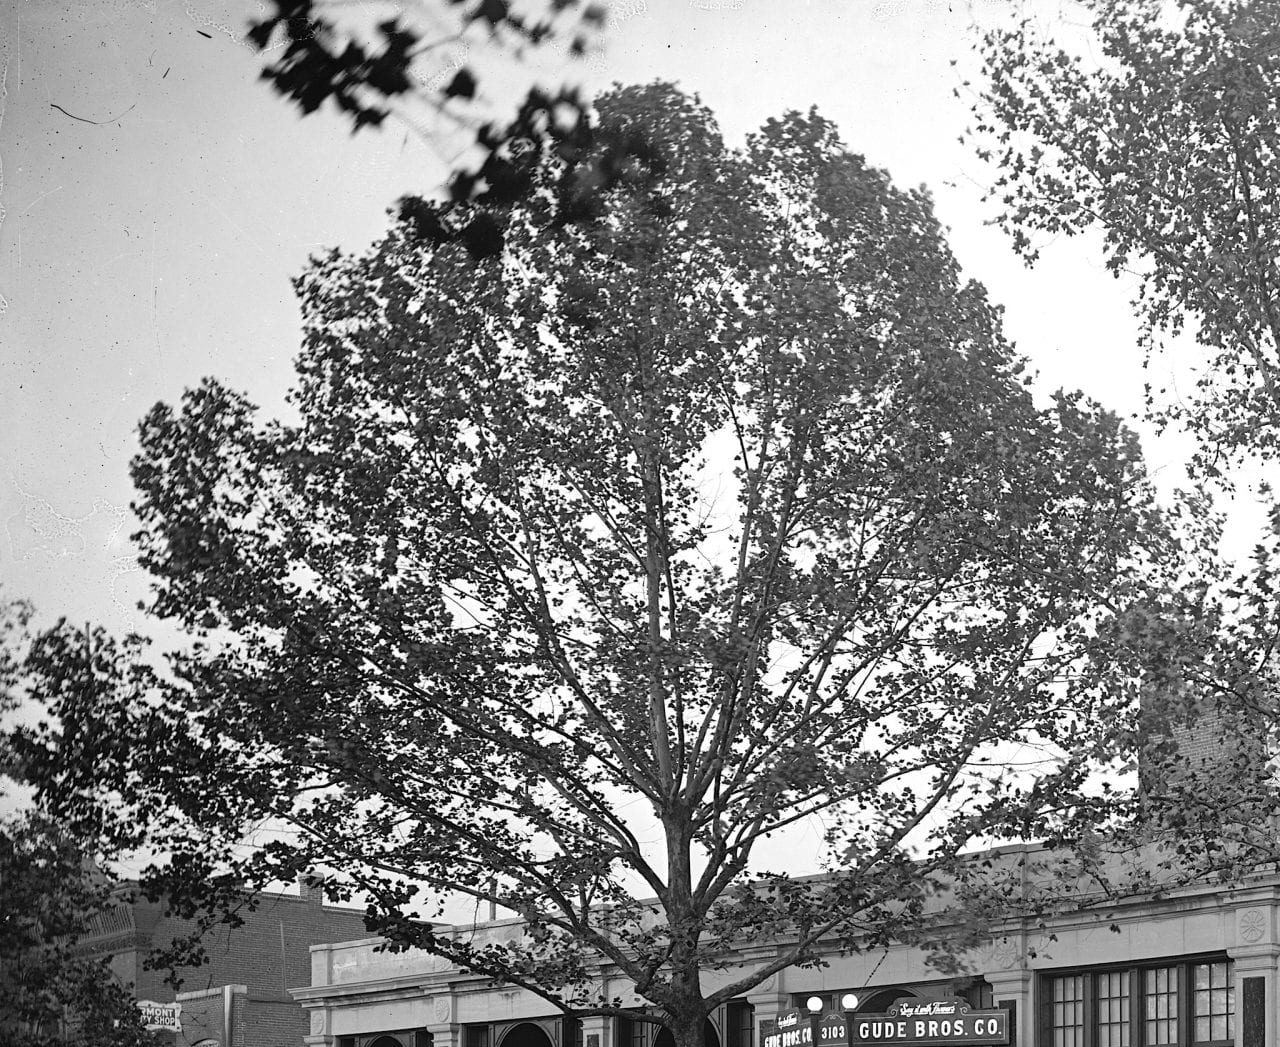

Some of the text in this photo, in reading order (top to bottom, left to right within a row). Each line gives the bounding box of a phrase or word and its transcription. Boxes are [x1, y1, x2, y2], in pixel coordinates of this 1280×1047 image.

[154, 1016, 175, 1026] SHOP
[859, 1018, 1002, 1039] GUDE BROS. CO.
[782, 1029, 801, 1047] BROS.
[821, 1026, 845, 1040] 3103
